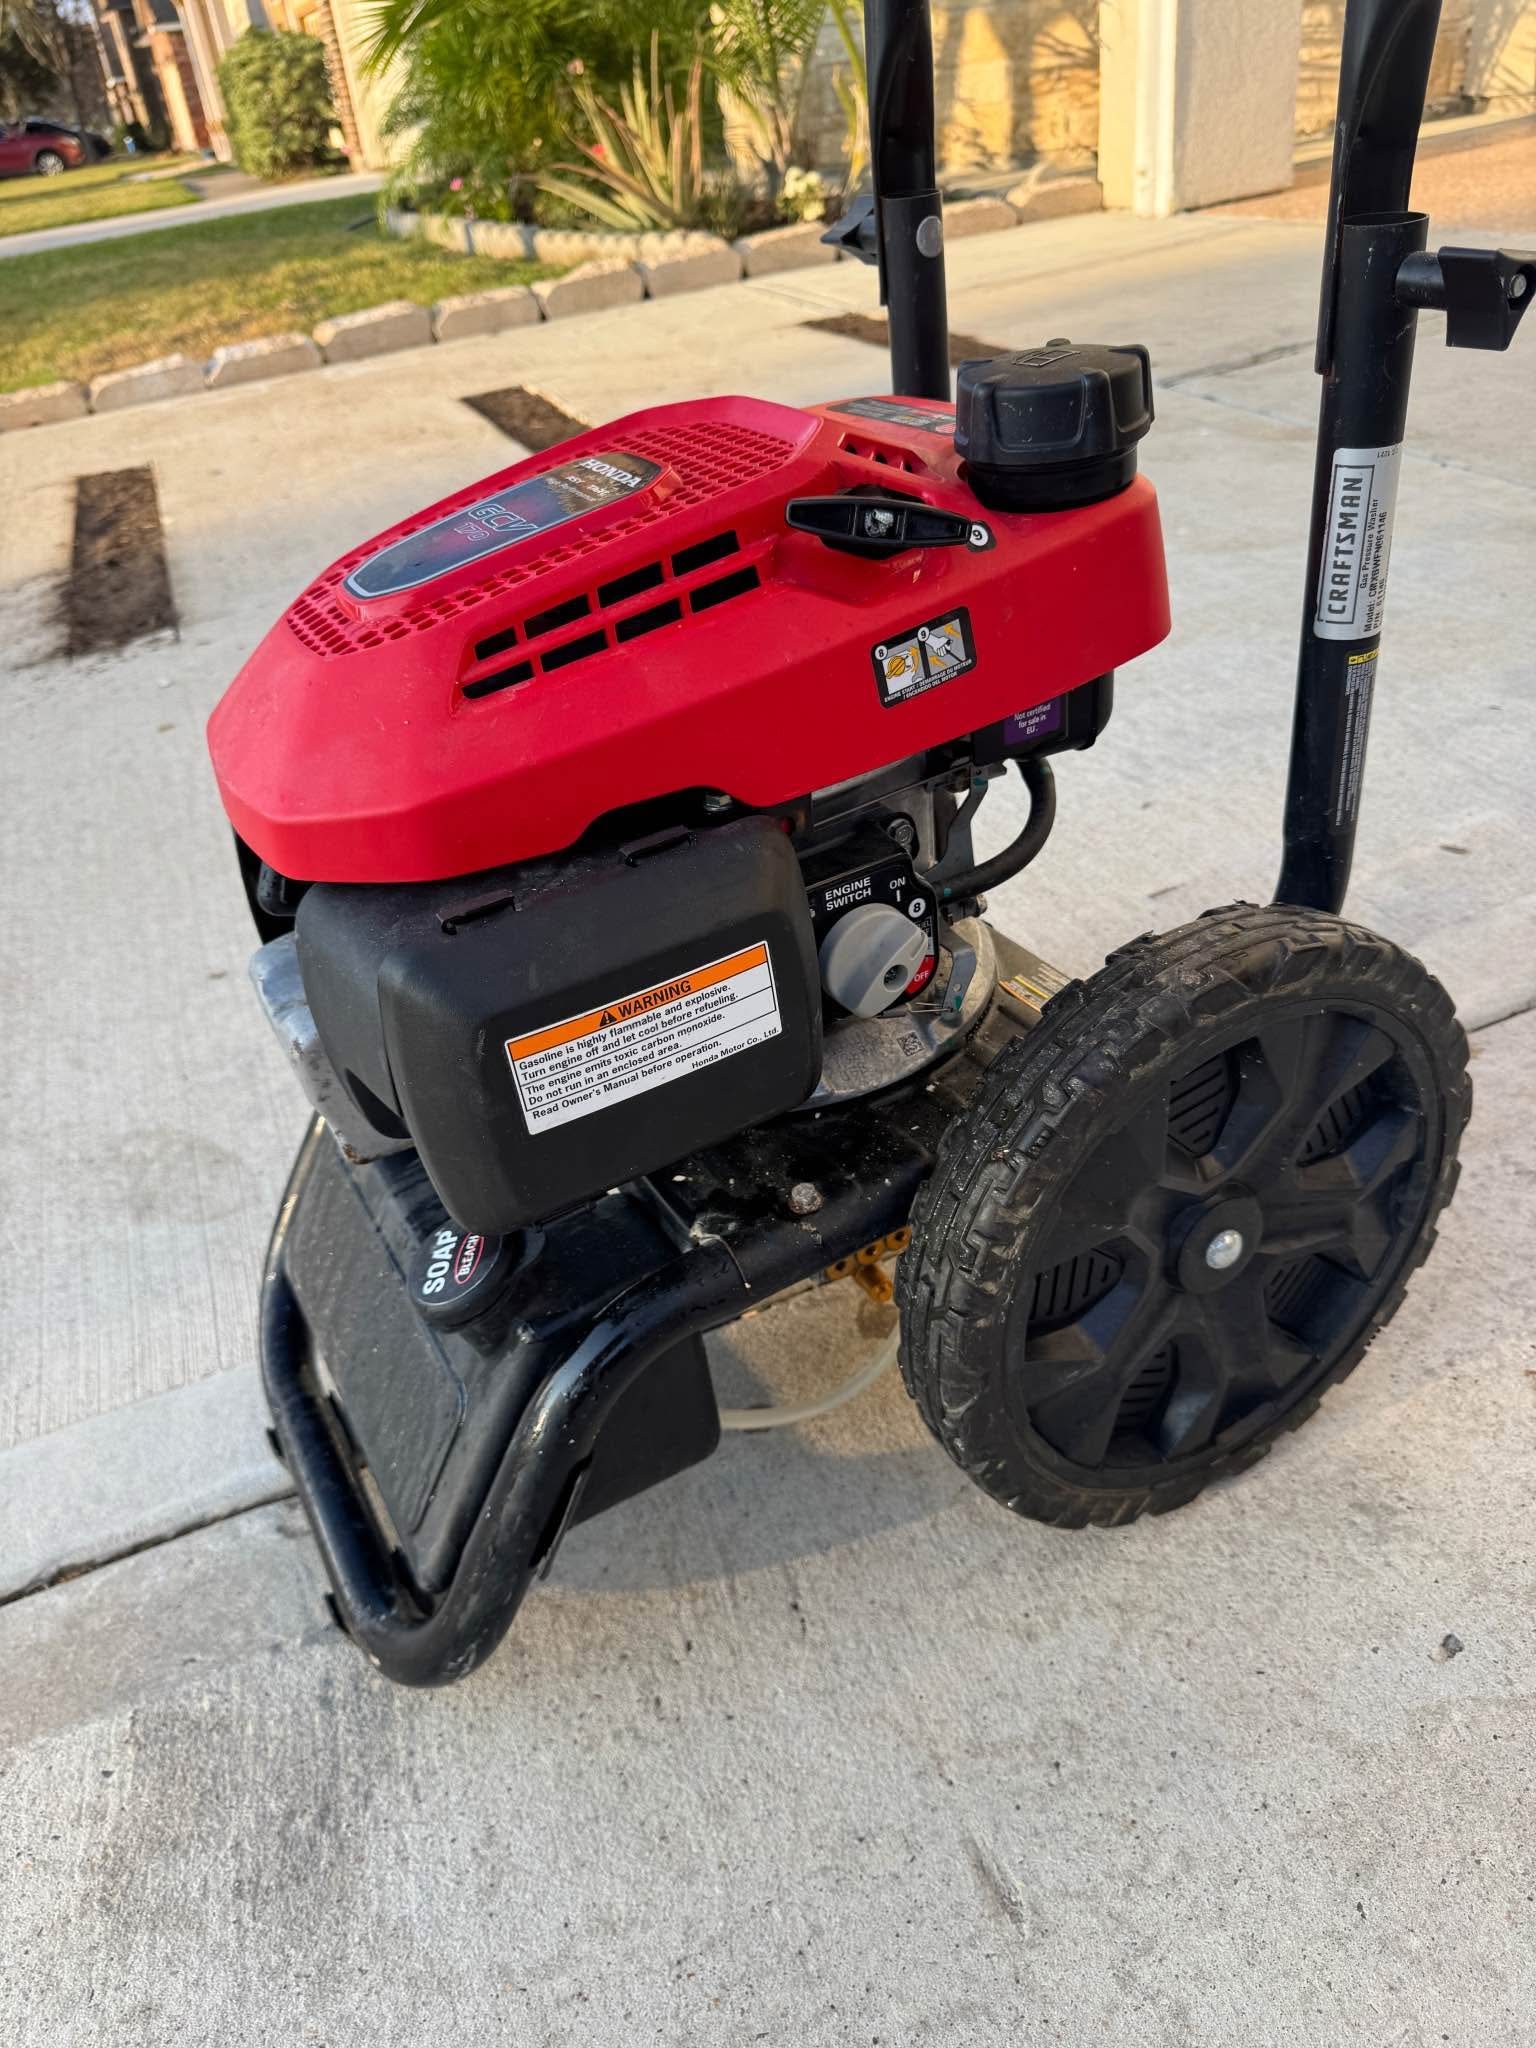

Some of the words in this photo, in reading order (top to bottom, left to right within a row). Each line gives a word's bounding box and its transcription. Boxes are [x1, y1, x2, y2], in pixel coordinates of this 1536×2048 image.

[580, 458, 642, 488] HONDA
[468, 503, 538, 532] GCV
[1368, 499, 1378, 531] Washer
[454, 522, 489, 541] 170
[972, 529, 982, 541] 9
[1327, 478, 1362, 614] CRAFTSMAN
[1362, 534, 1373, 570] Pressure
[1360, 573, 1368, 588] Gas
[1363, 600, 1375, 632] Model:
[941, 671, 958, 682] MOTOR
[1014, 712, 1025, 721] Not
[1027, 703, 1051, 717] certified
[1018, 720, 1027, 729] for
[1028, 716, 1039, 725] sale
[825, 877, 871, 900] ENGINE
[889, 877, 906, 889] ON
[826, 887, 872, 911] SWITCH
[913, 903, 921, 912] 8
[913, 970, 929, 982] OFF
[618, 980, 692, 1017] WARNING
[519, 1050, 563, 1071] Gasoline
[566, 1045, 575, 1054] is
[577, 1033, 607, 1049] highly
[609, 1011, 661, 1037] flammable
[664, 1002, 682, 1016] and
[685, 984, 731, 1007] explosive.
[521, 1068, 546, 1081] Turn
[549, 1055, 582, 1071] engine
[586, 1047, 599, 1058] off
[602, 1038, 620, 1052] and
[623, 1033, 635, 1044] let
[638, 1025, 658, 1037] cool
[661, 1010, 692, 1028] before
[695, 992, 739, 1014] refueling.
[525, 1082, 545, 1095] The
[548, 1070, 582, 1087] engine
[585, 1058, 612, 1073] emits
[614, 1047, 638, 1062] toxic
[641, 1034, 674, 1051] carbon
[677, 1012, 726, 1037] monoxide.
[692, 1054, 719, 1069] Honda
[720, 1042, 745, 1057] Motor
[763, 1027, 779, 1038] Ltd.
[528, 1096, 543, 1105] Do
[546, 1088, 562, 1099] not
[565, 1082, 582, 1093] run
[585, 1077, 594, 1085] in
[597, 1071, 609, 1080] an
[612, 1051, 655, 1073] enclosed
[657, 1042, 682, 1056] area.
[532, 1104, 559, 1119] Read
[561, 1089, 601, 1108] Owner's
[603, 1072, 638, 1093] Manual
[642, 1059, 672, 1077] before
[675, 1040, 722, 1064] operation.
[422, 1230, 458, 1295] SOAP
[459, 1234, 480, 1275] BLEACH
